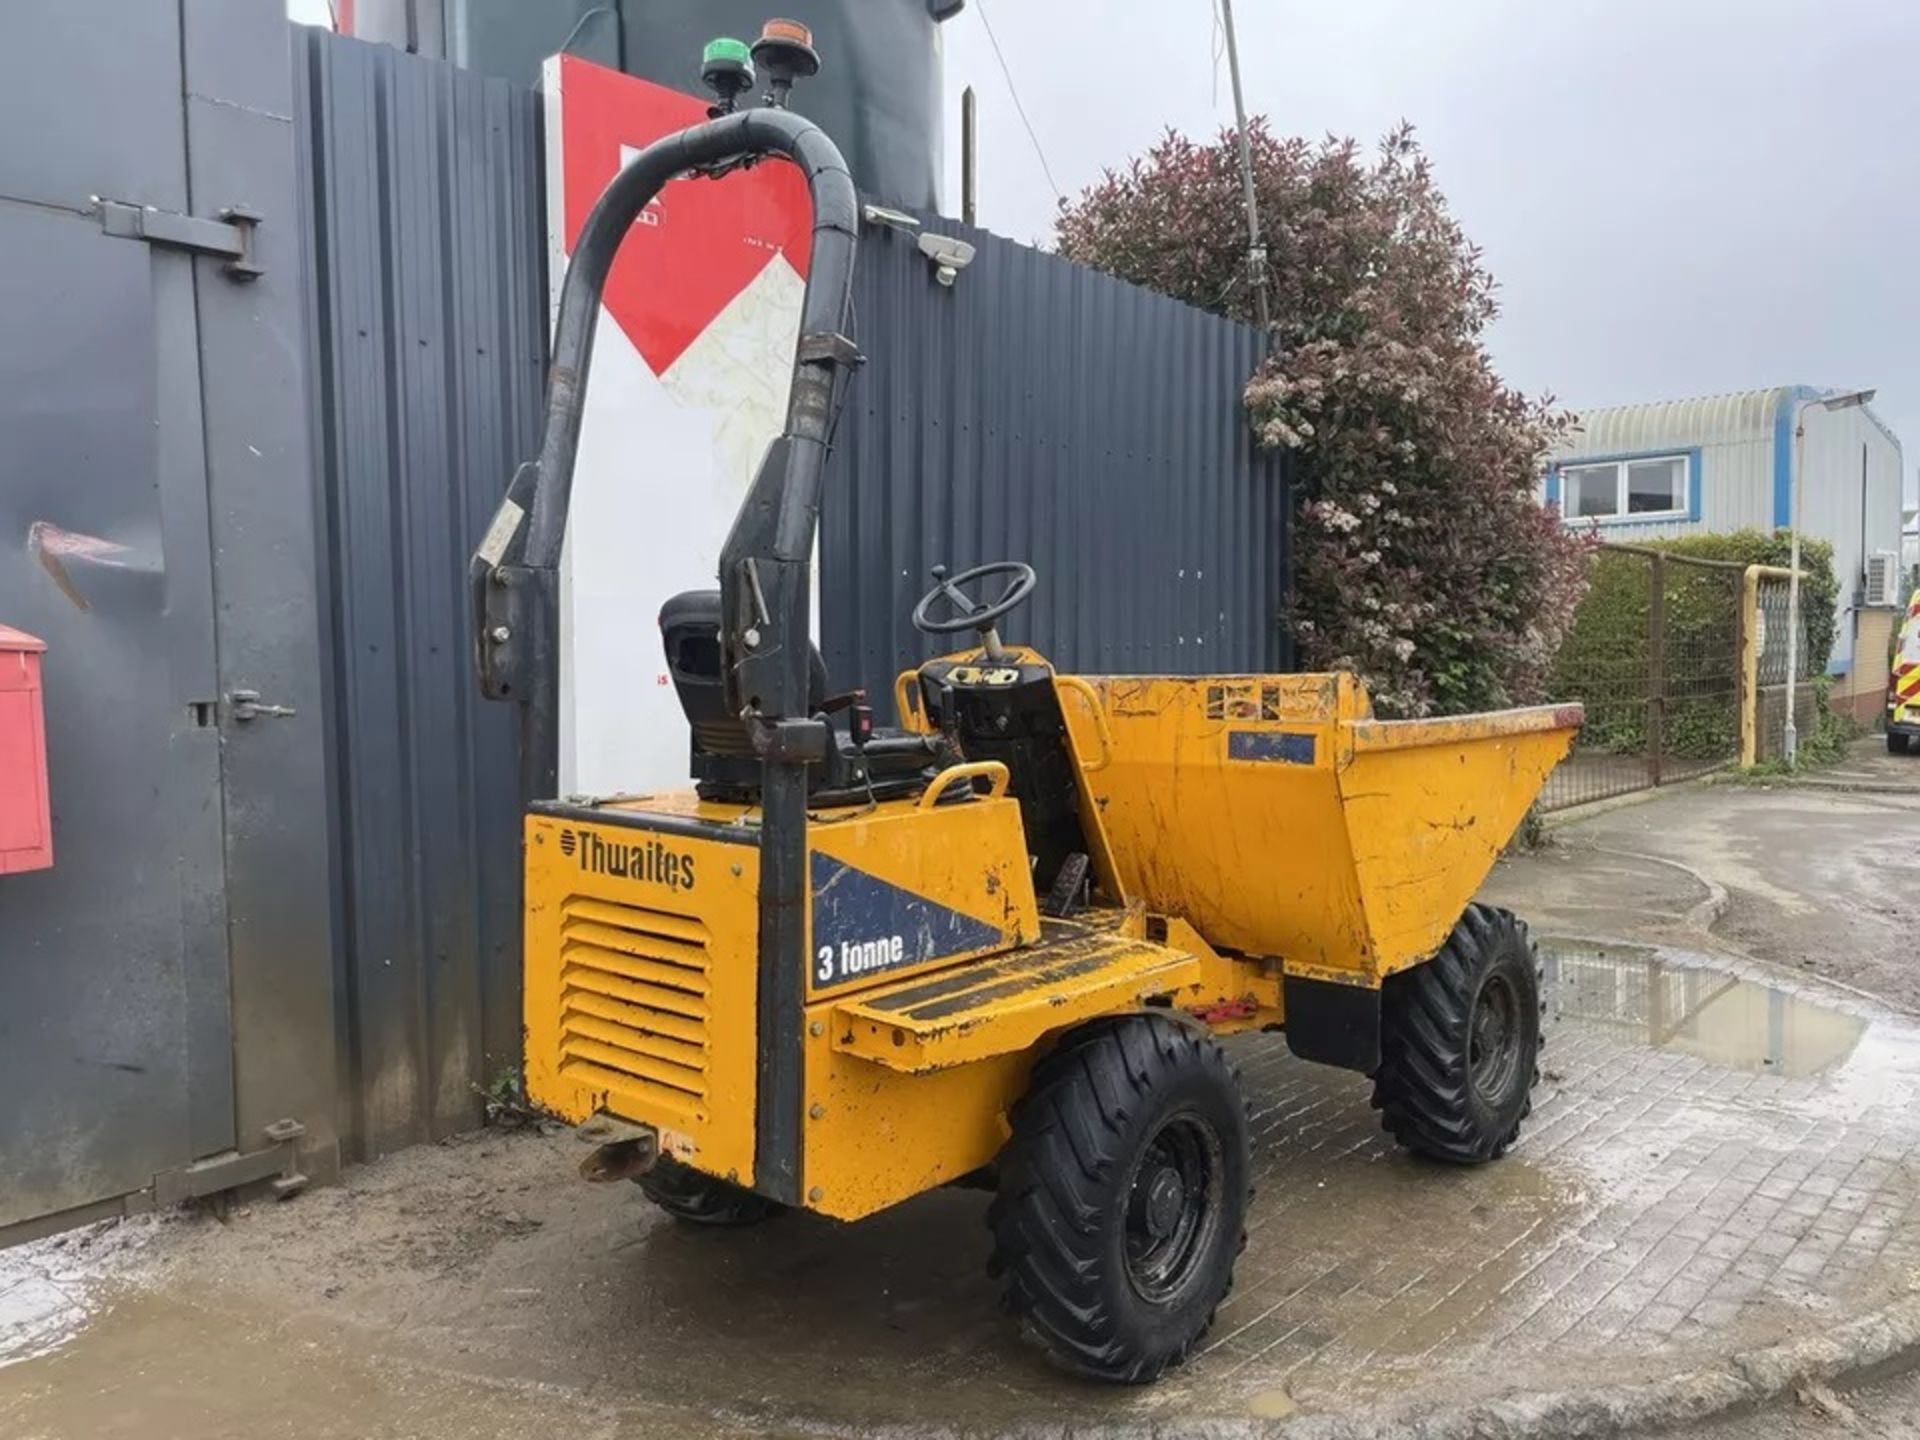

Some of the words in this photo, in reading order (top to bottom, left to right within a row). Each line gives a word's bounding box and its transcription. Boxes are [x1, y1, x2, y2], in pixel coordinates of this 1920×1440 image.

[577, 829, 694, 890] Thwaites
[818, 944, 834, 981] 3
[841, 934, 903, 975] tonne
